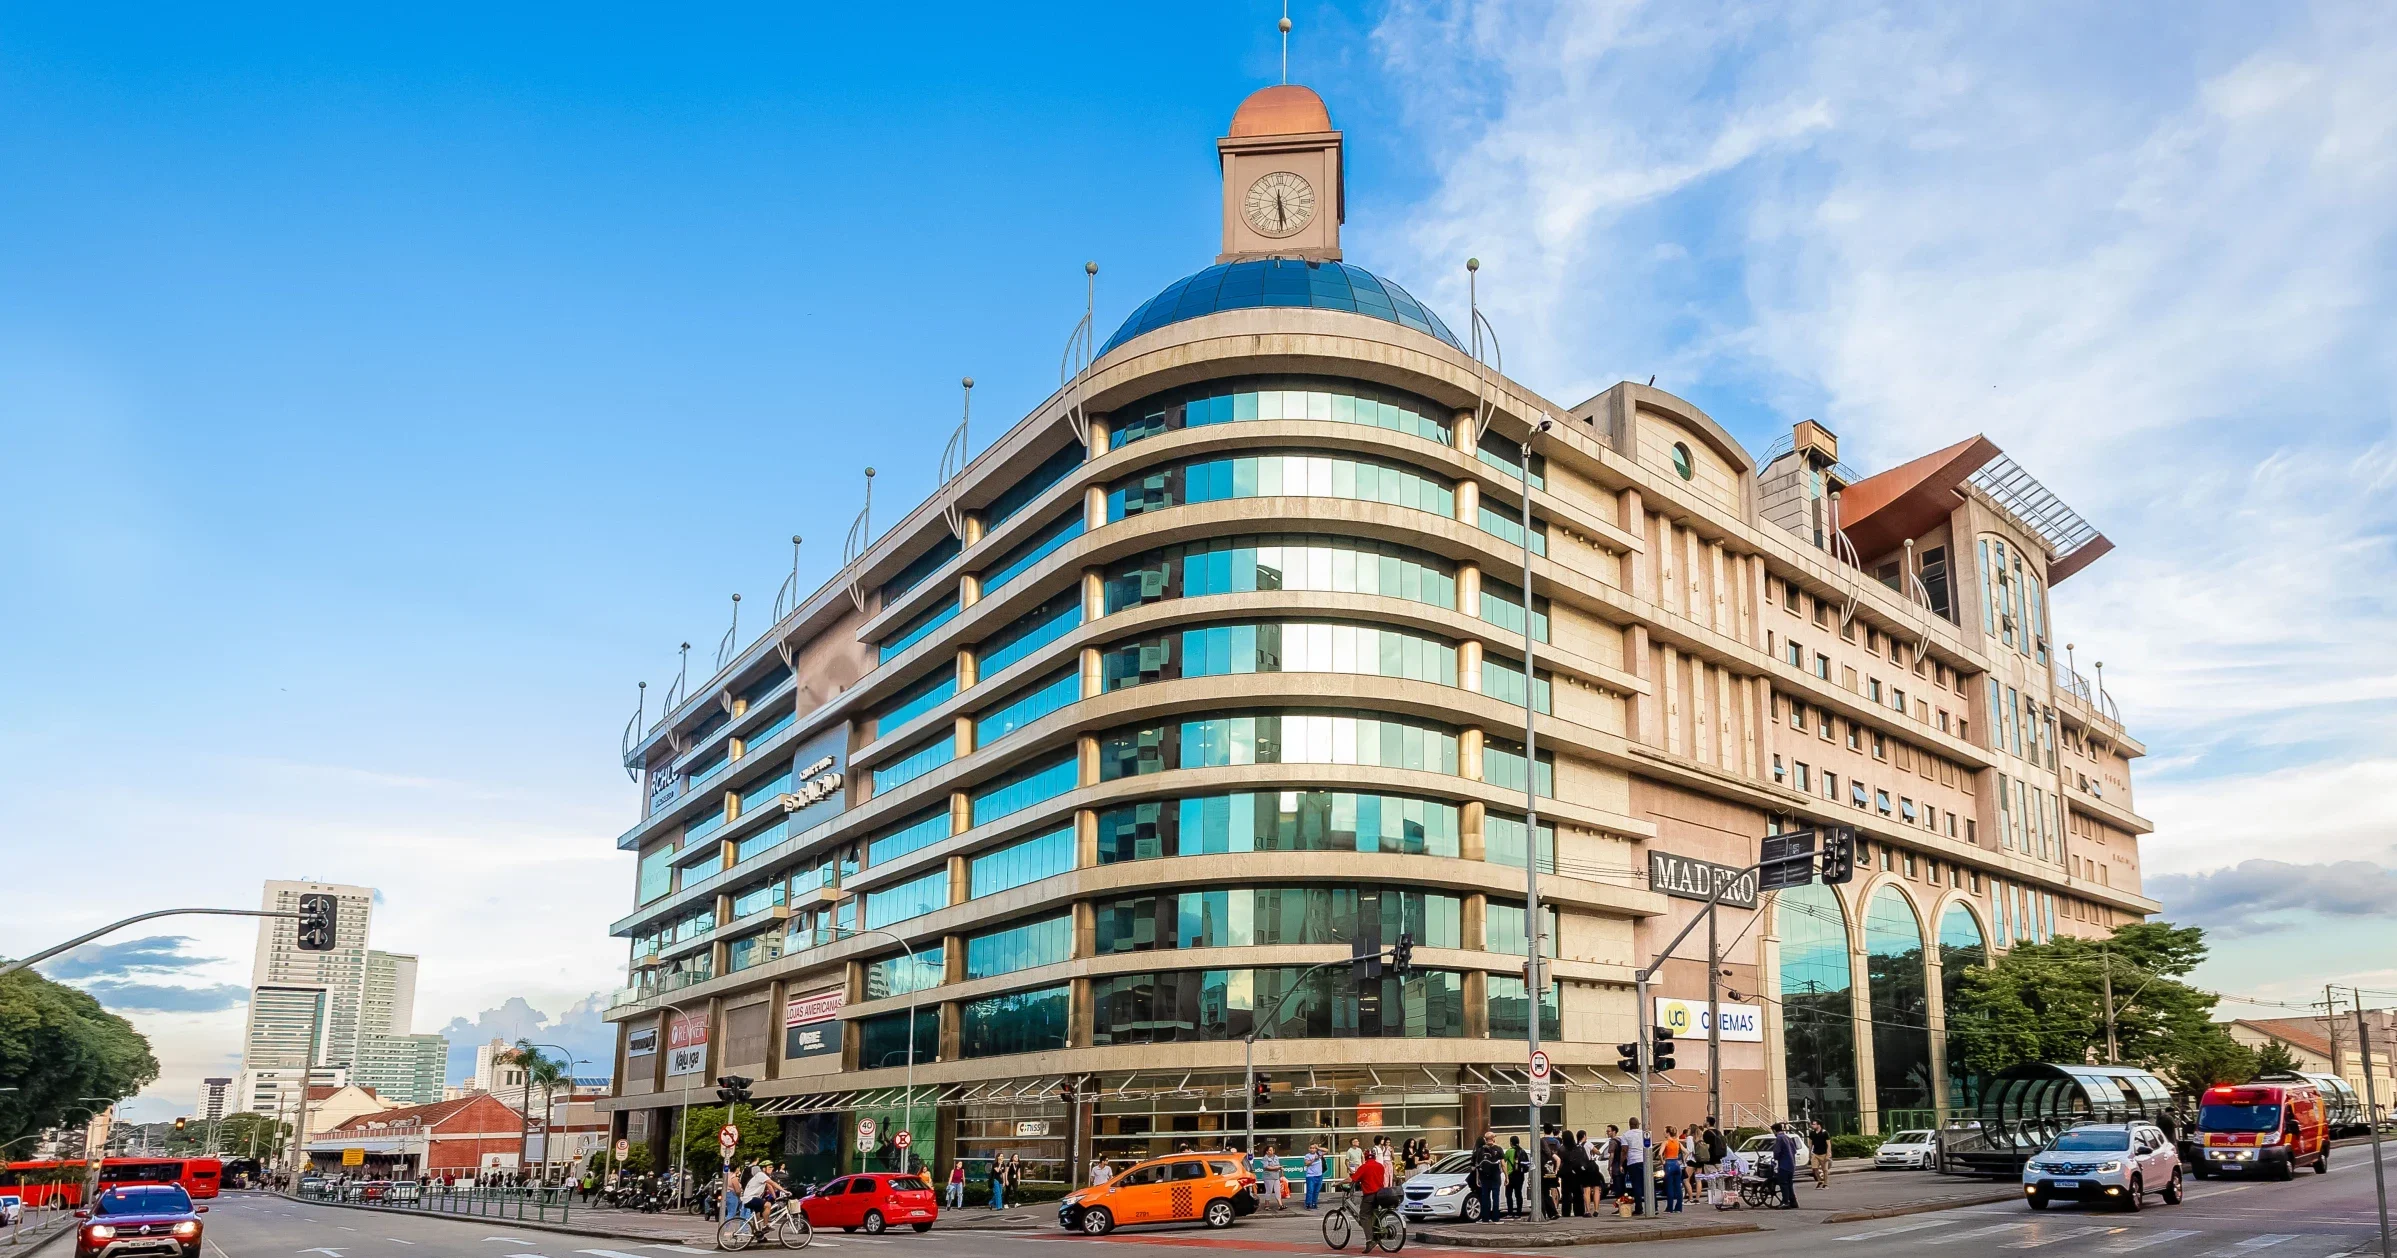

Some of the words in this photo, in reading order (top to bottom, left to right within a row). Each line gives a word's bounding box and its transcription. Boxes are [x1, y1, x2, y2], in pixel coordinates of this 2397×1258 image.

[1655, 856, 1754, 903] MADERO
[787, 1006, 804, 1020] LOJAS
[804, 998, 843, 1017] AMERICANAS
[1701, 1011, 1754, 1032] CEMAS
[861, 1121, 873, 1130] 40
[1282, 1165, 1304, 1173] hopping
